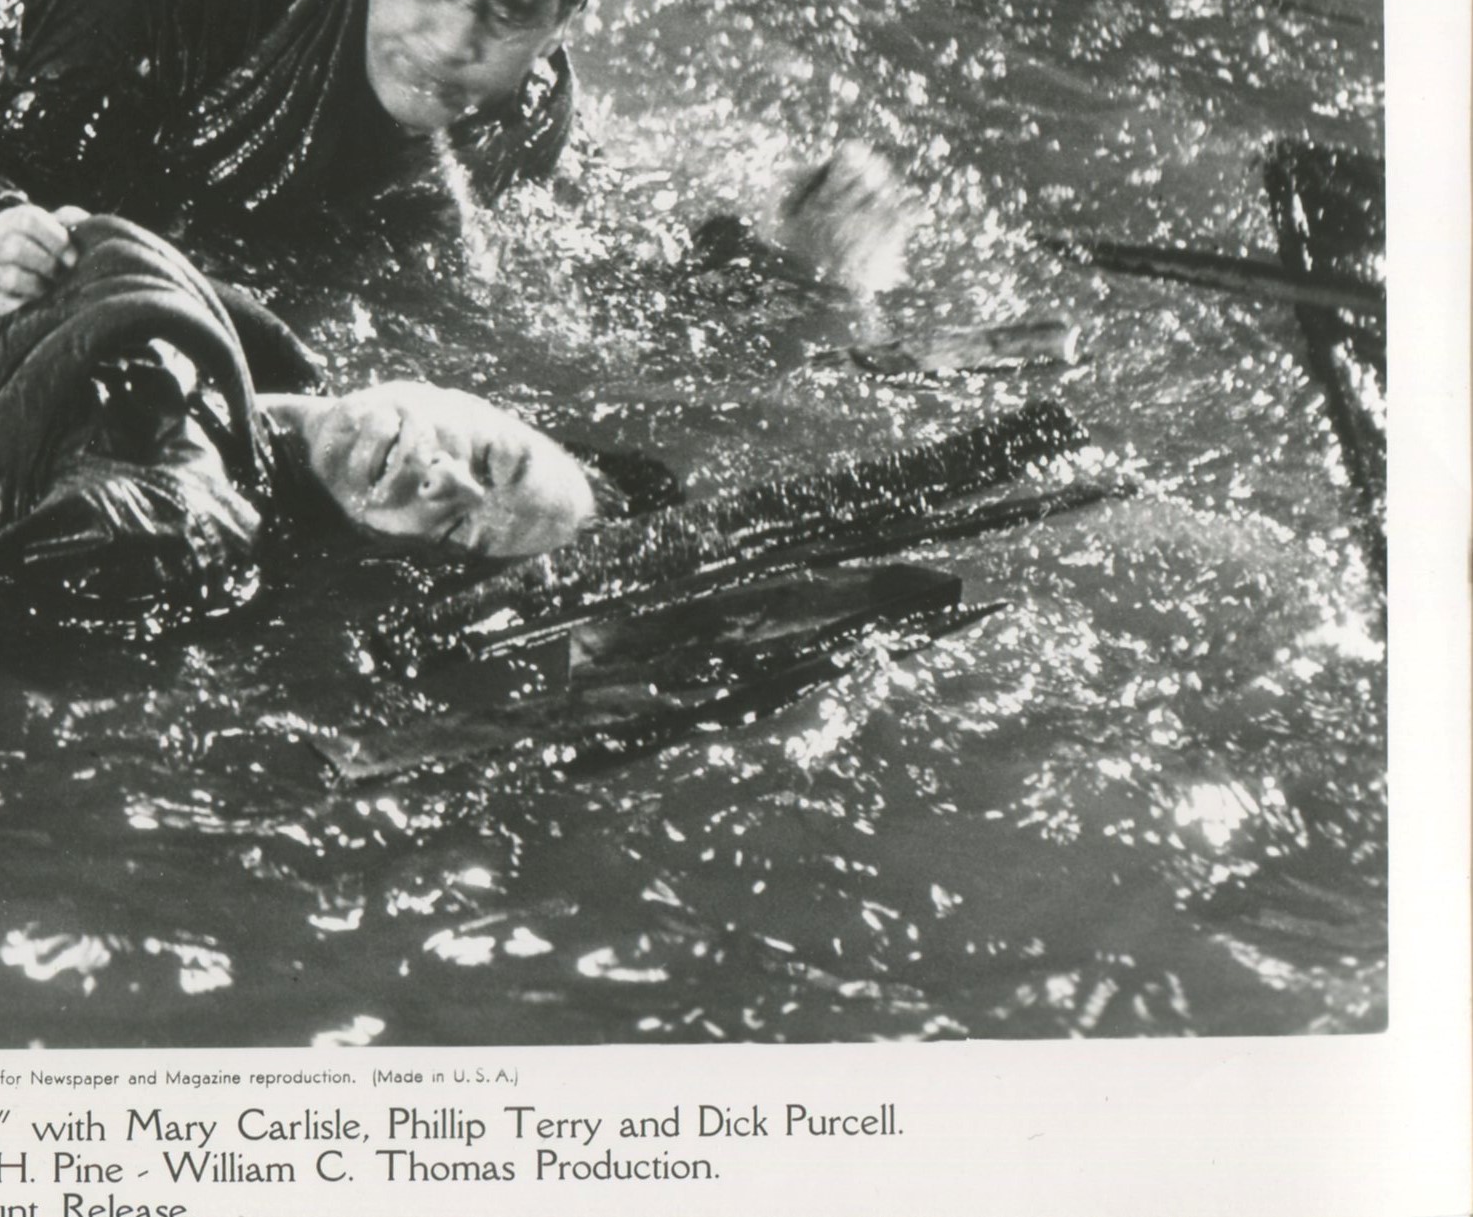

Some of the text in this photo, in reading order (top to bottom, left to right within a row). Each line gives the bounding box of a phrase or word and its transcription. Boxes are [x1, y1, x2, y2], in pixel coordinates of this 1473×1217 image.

[0, 1069, 22, 1090] for
[30, 1070, 120, 1089] Newspaper
[128, 1071, 157, 1086] and
[165, 1071, 241, 1089] Magazine
[249, 1071, 356, 1089] reproduction.
[372, 1069, 423, 1087] (Made
[432, 1070, 445, 1084] in
[31, 1109, 106, 1142] with
[126, 1108, 218, 1149] Mary
[237, 1107, 370, 1144] Carlisle,
[388, 1106, 486, 1147] Phillip
[503, 1105, 603, 1147] Terry
[619, 1104, 680, 1139] and
[698, 1104, 769, 1138] Dick
[785, 1103, 904, 1137] Purcell.
[53, 1151, 124, 1184] Pine
[162, 1150, 296, 1184] William
[315, 1149, 354, 1183] C.
[375, 1149, 516, 1182] Thomas
[536, 1148, 720, 1181] Production.
